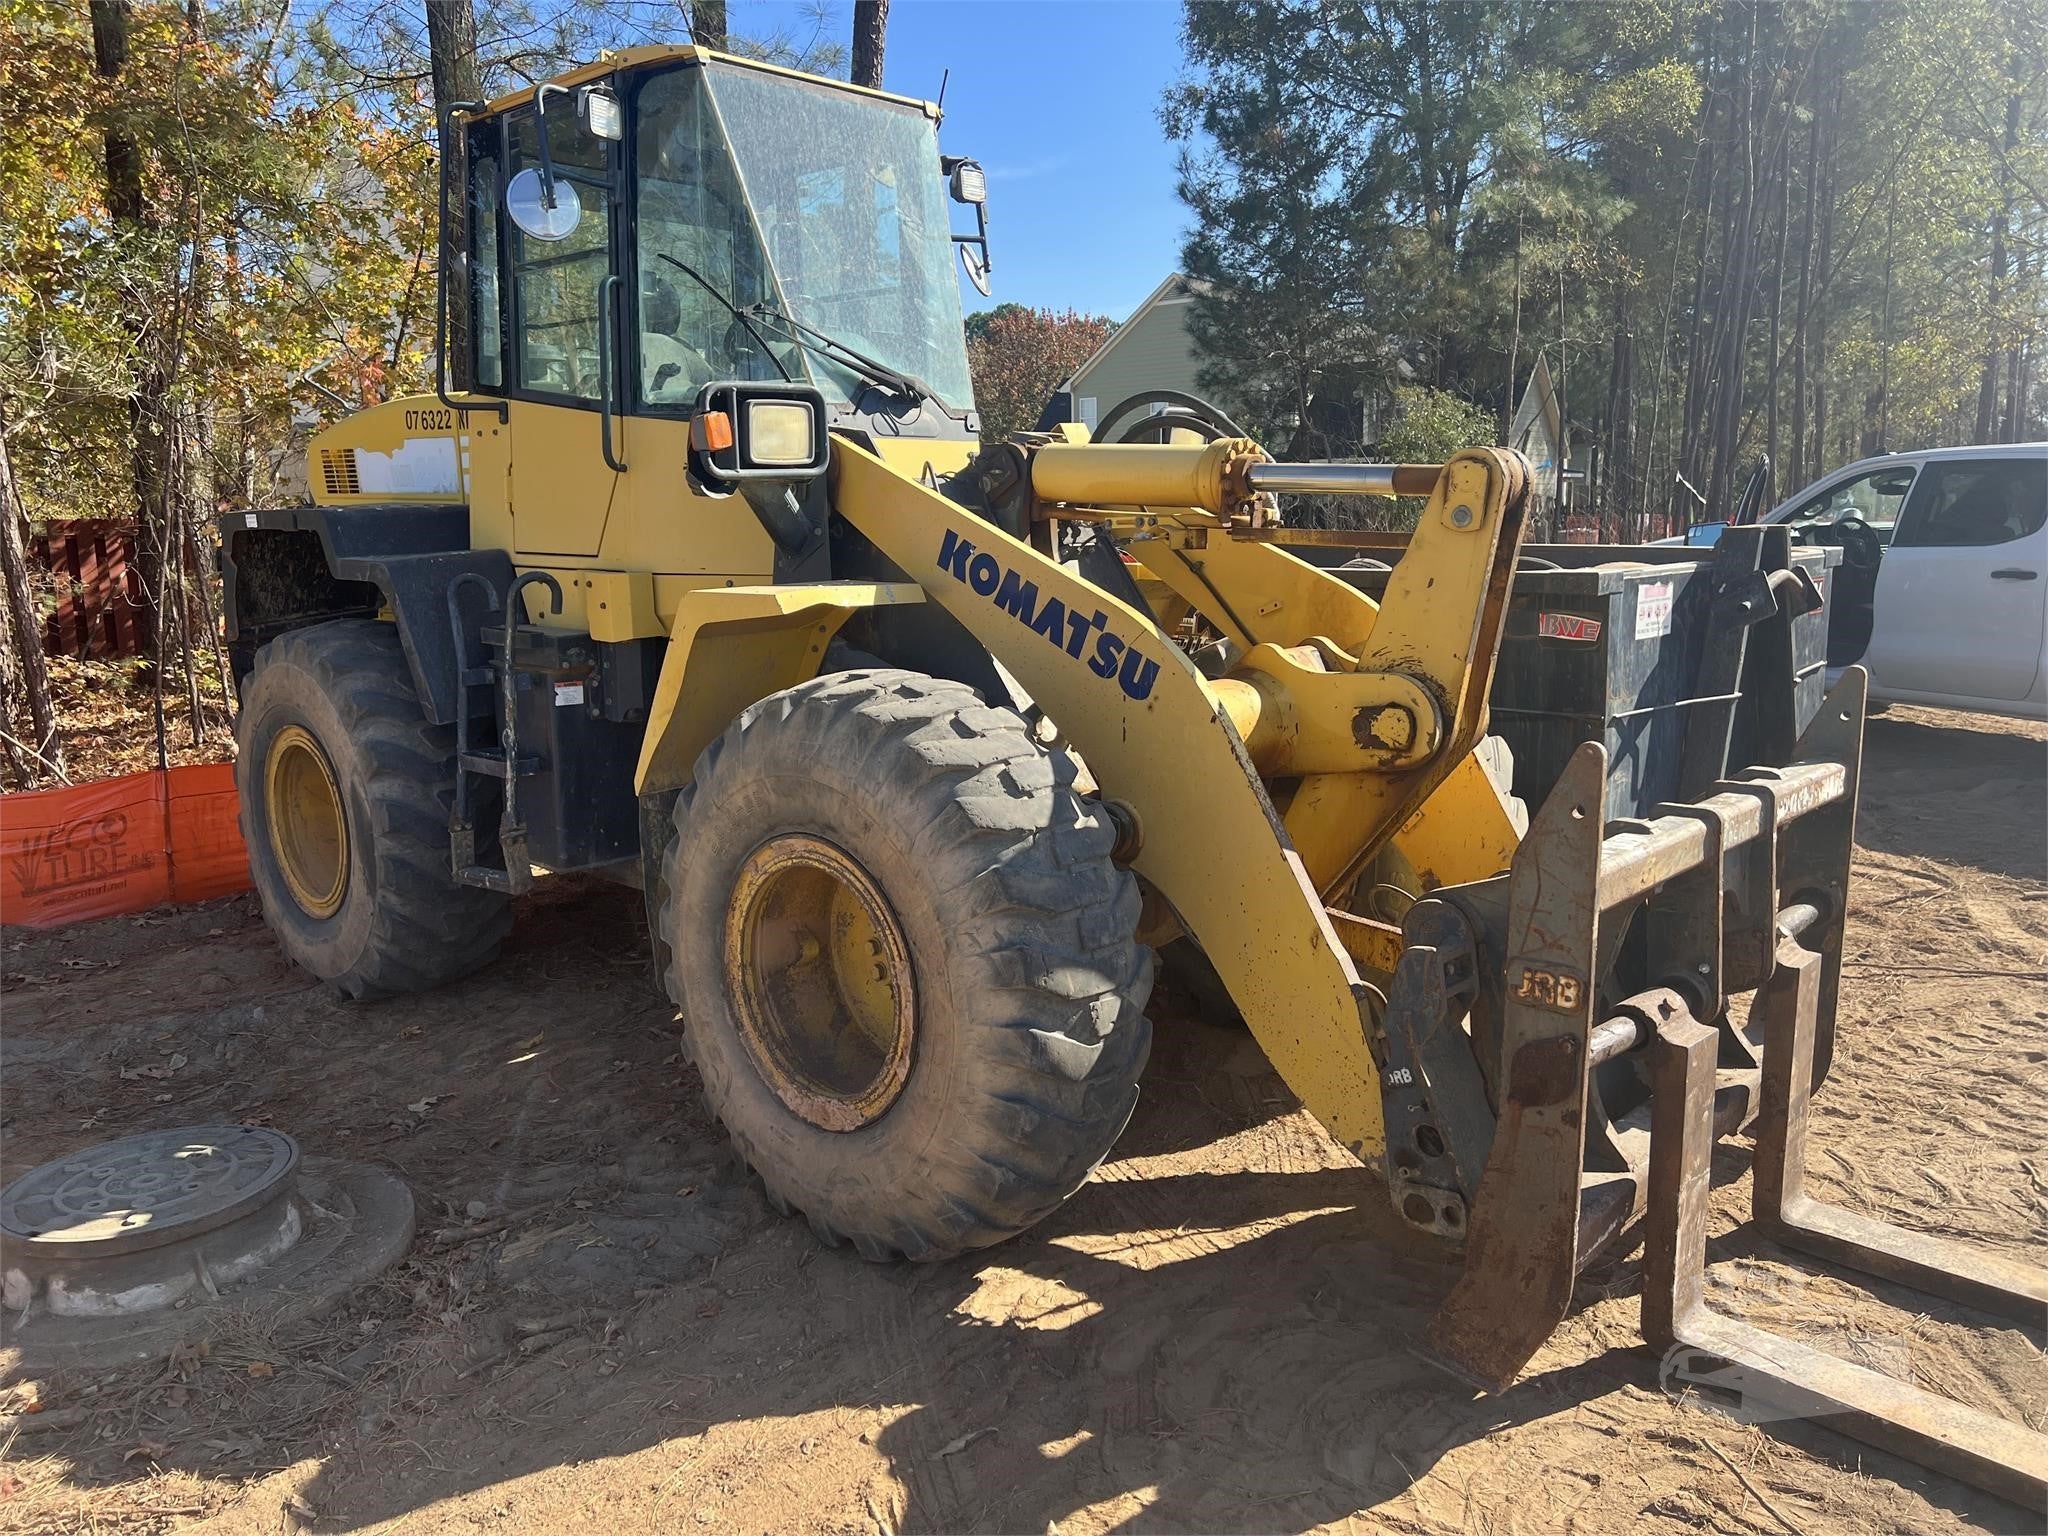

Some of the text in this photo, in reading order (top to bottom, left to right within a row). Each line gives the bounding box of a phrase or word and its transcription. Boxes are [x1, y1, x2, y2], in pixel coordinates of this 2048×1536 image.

[405, 409, 452, 430] 076322
[937, 528, 1160, 700] KOMATSU
[1519, 969, 1580, 1008] JRB
